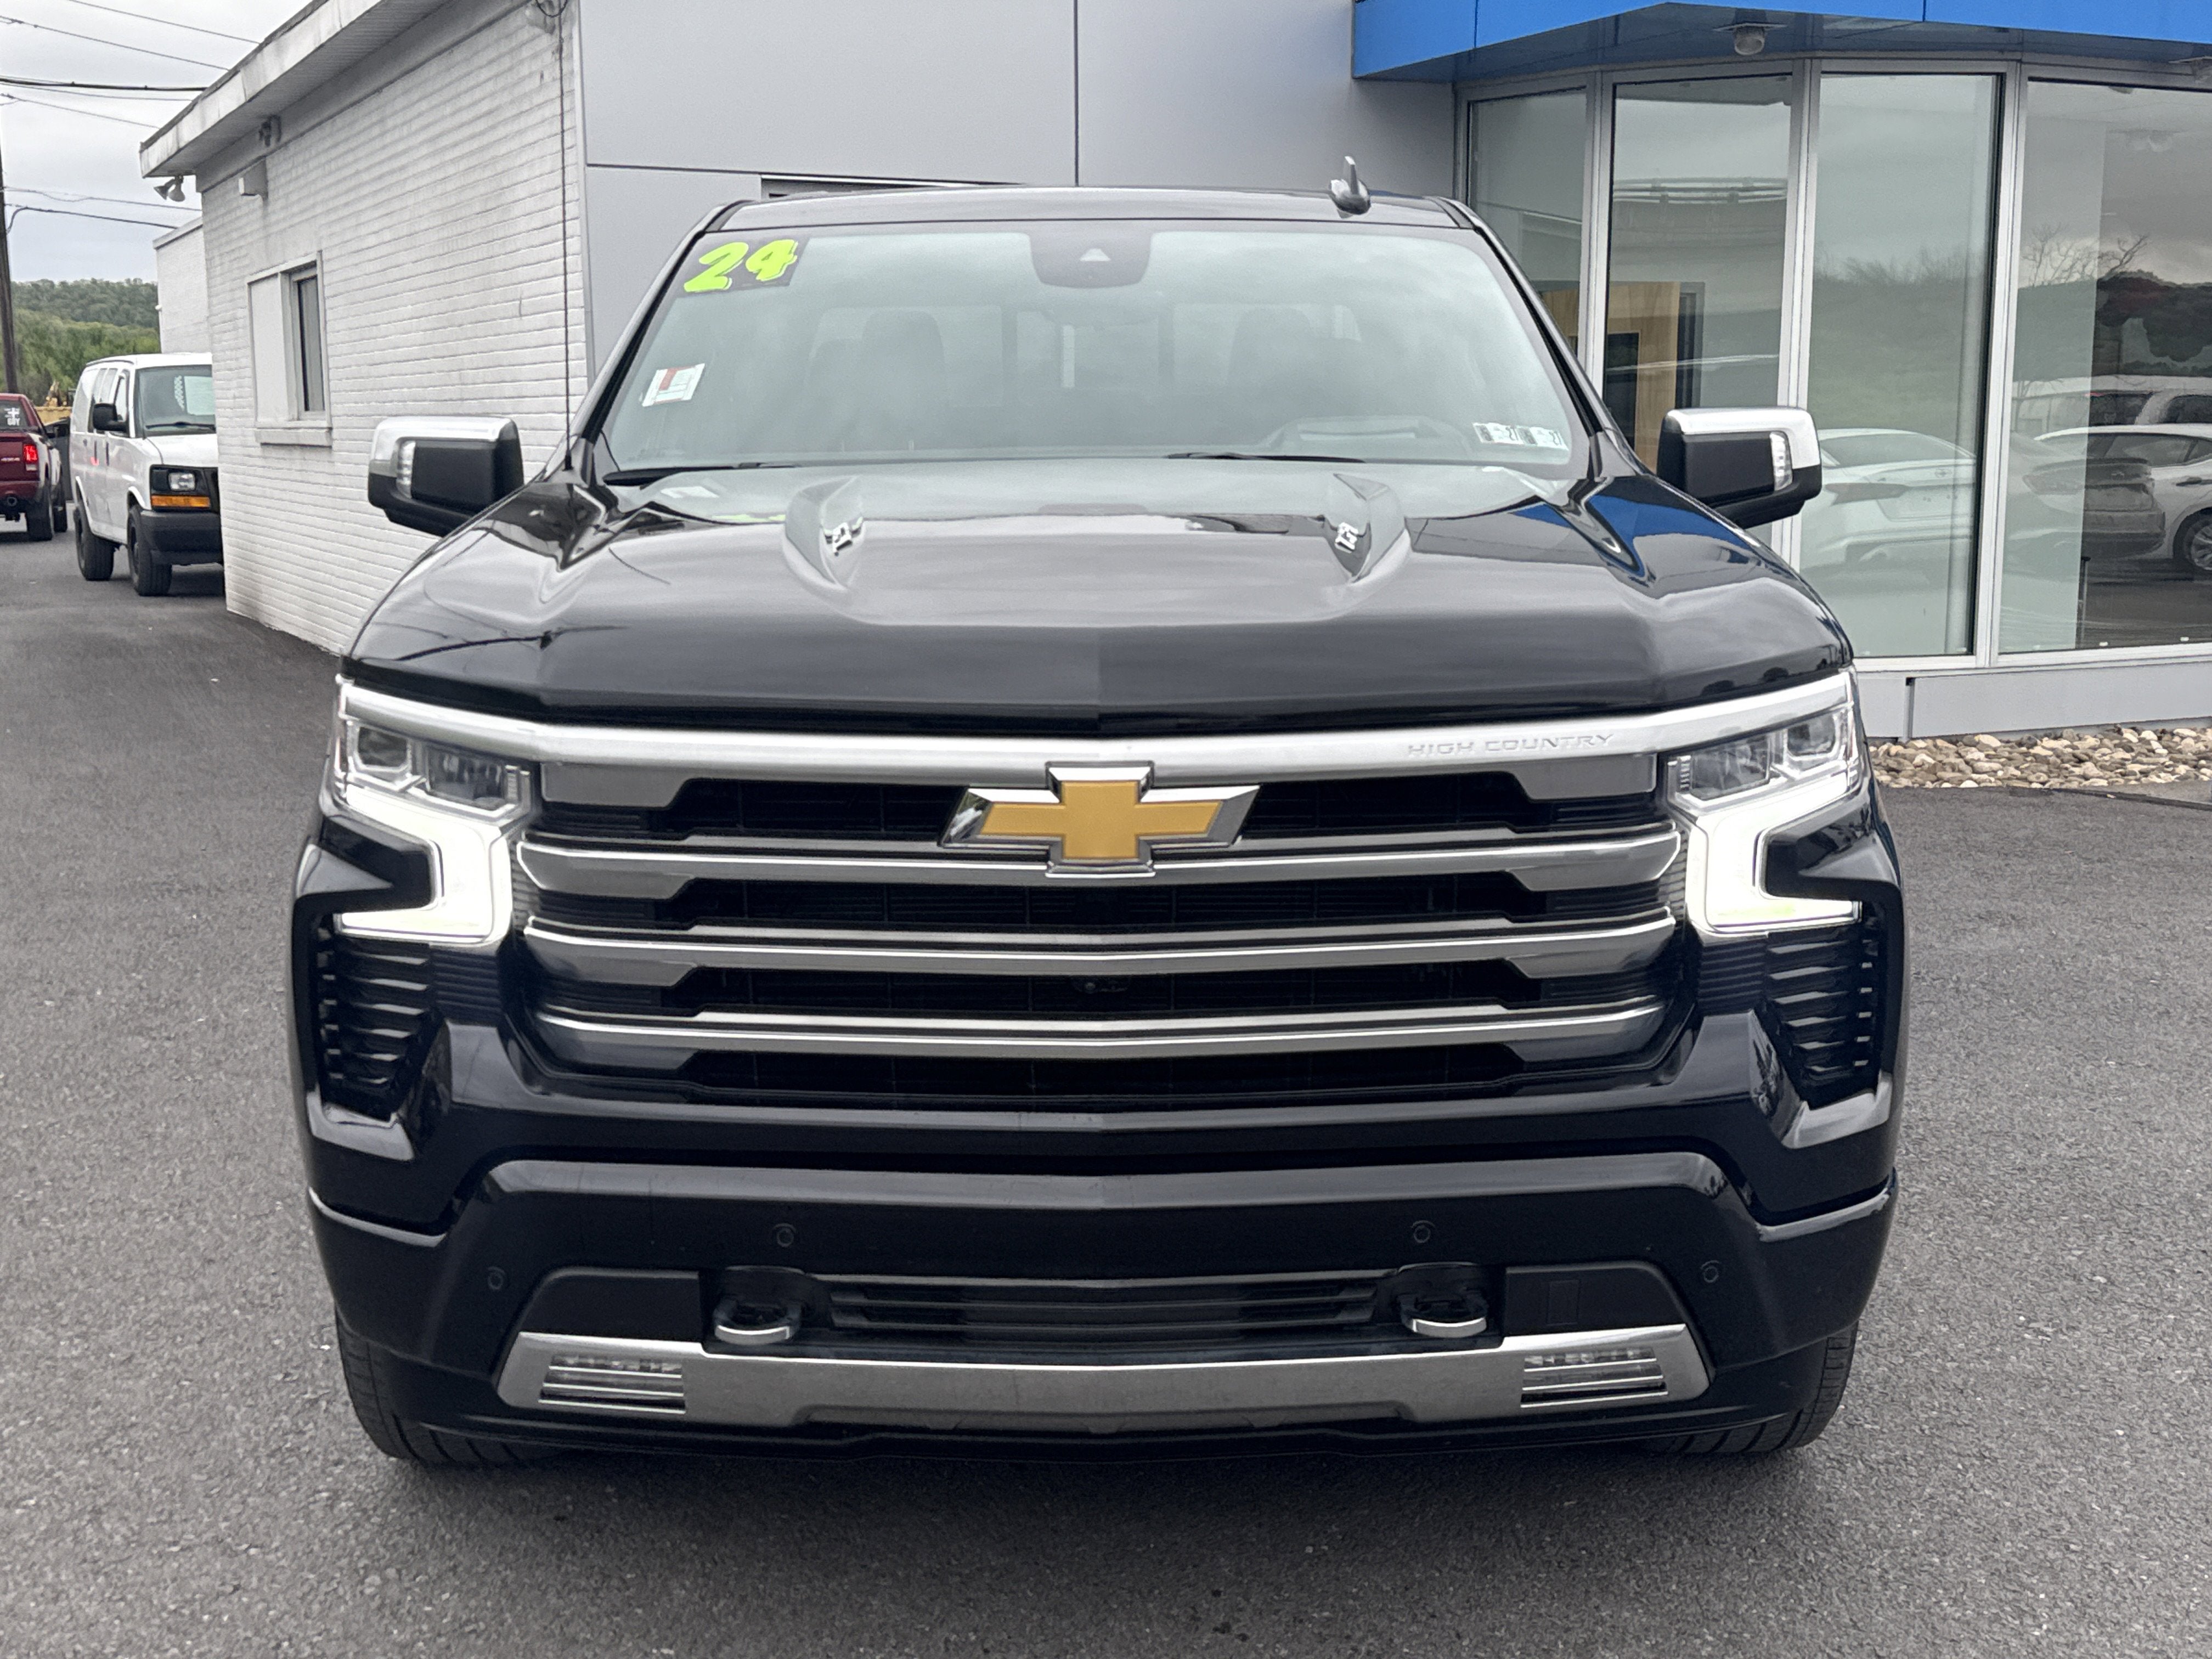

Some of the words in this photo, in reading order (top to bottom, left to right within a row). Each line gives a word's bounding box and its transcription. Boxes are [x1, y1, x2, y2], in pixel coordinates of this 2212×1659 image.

[684, 239, 798, 292] 24
[1408, 742, 1475, 756] HIGH
[1485, 733, 1614, 752] COUNTRY
